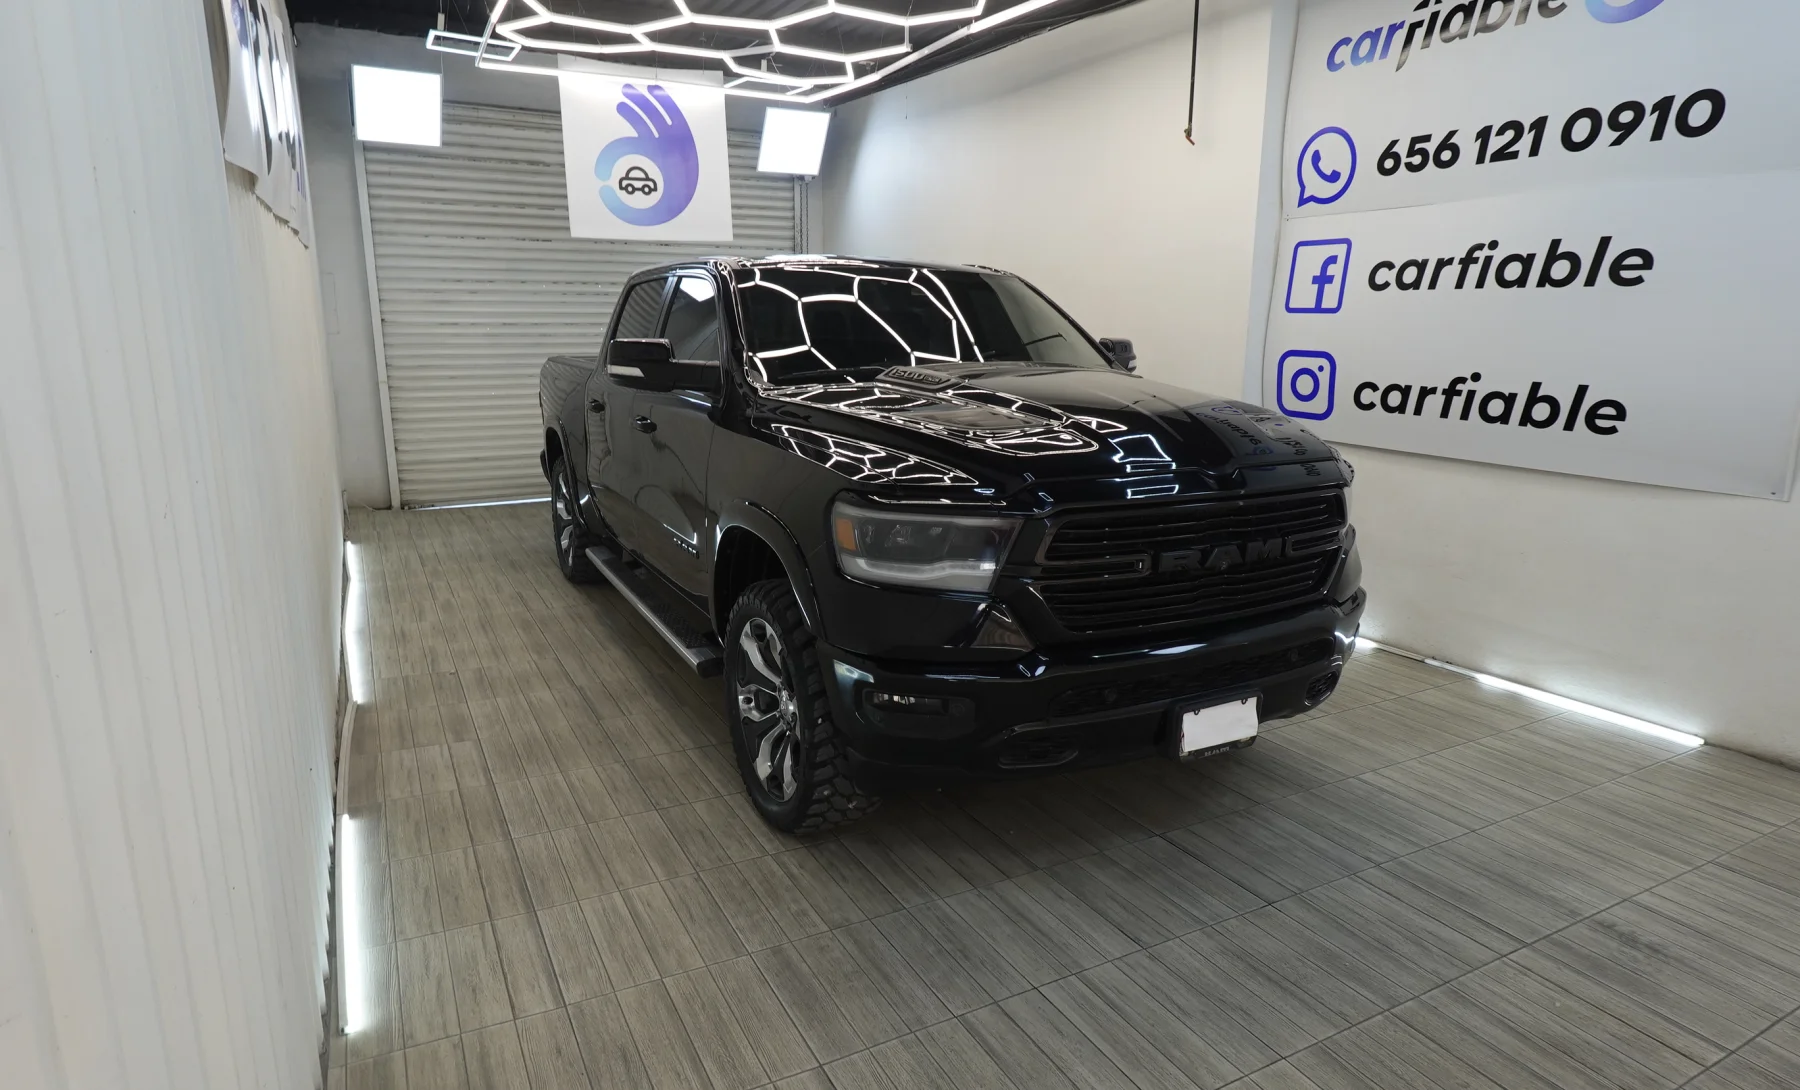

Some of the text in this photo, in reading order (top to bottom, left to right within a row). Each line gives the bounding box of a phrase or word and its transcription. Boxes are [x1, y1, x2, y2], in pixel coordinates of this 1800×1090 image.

[1376, 88, 1726, 177] 656 121 0910
[1368, 235, 1655, 292] carfiable
[1353, 371, 1627, 436] carfiable
[1158, 537, 1283, 573] RAM
